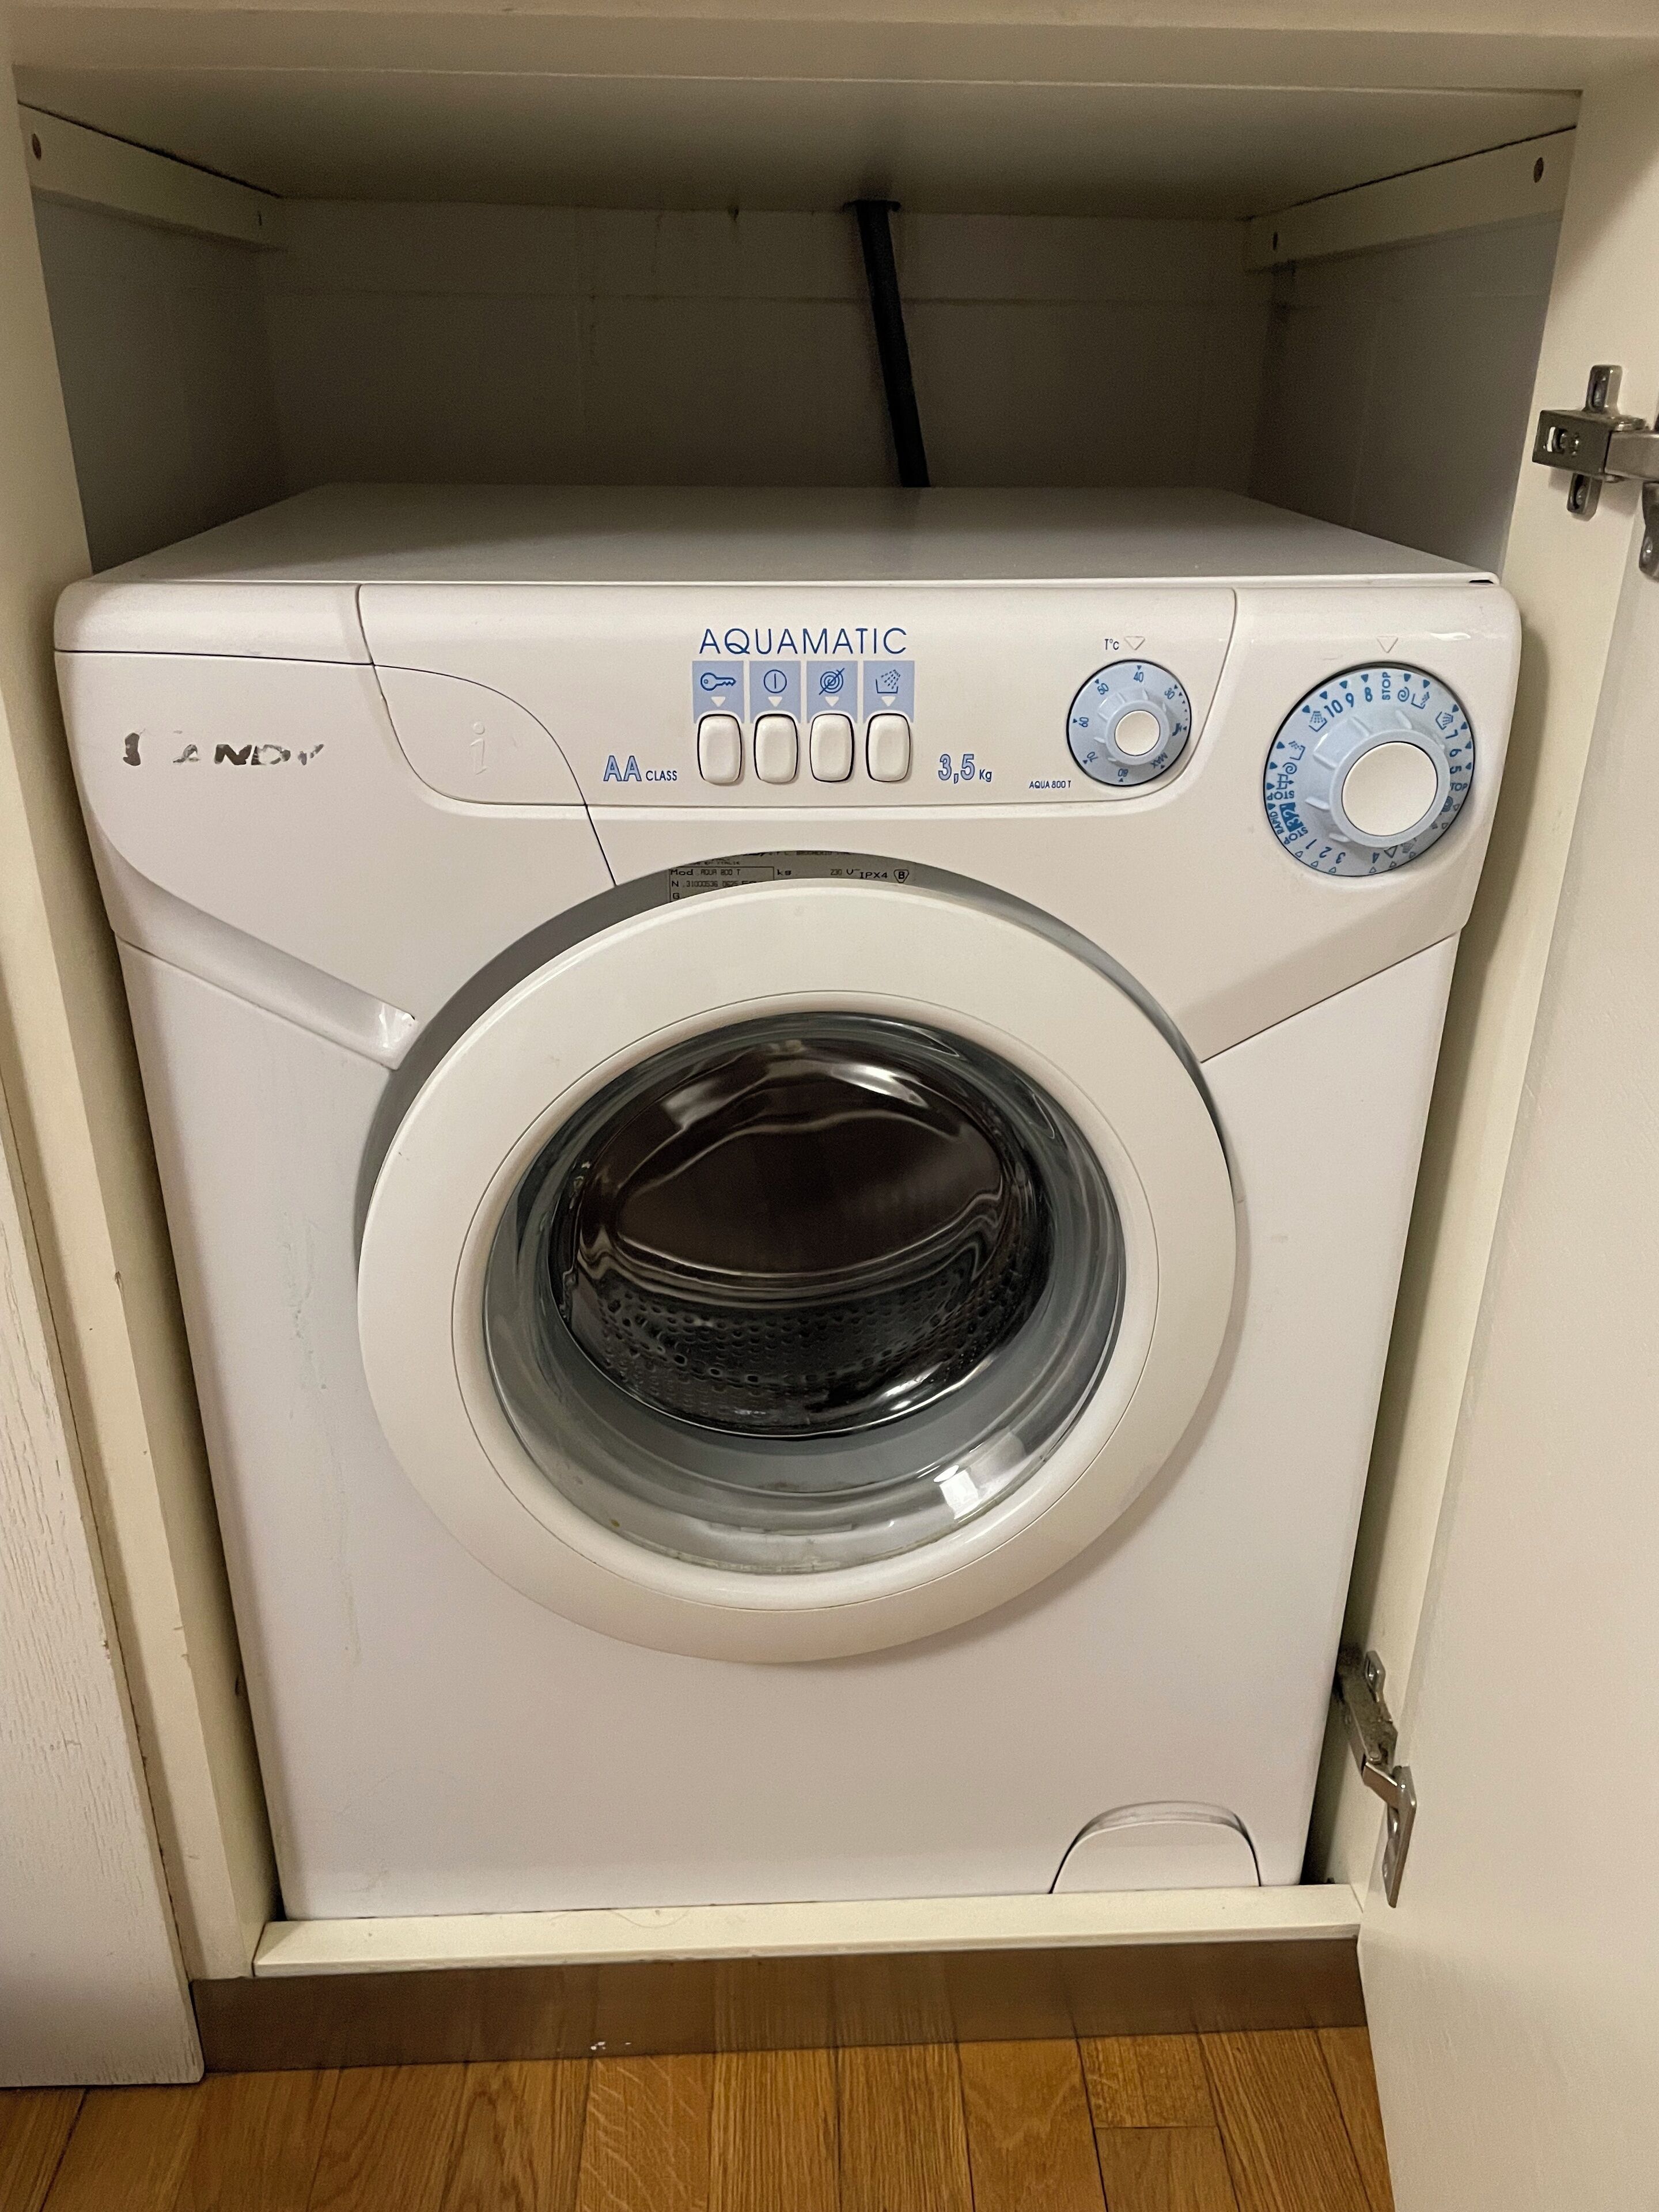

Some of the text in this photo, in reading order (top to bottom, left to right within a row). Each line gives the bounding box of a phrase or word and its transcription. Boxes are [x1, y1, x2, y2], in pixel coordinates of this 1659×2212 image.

[699, 627, 907, 655] AQUAMATIC
[1133, 671, 1144, 683] 40
[1097, 683, 1109, 695] 50
[1382, 672, 1391, 700] STOP
[1164, 687, 1175, 700] 30
[1364, 687, 1373, 703] 8
[1345, 692, 1354, 708] 9
[1323, 699, 1344, 718] 10
[1078, 717, 1089, 728] 60
[1445, 729, 1459, 739] 7
[1086, 751, 1099, 763] 70
[1449, 748, 1462, 757] 6
[1150, 752, 1168, 769] MAX
[603, 755, 677, 782] AA CLASS
[938, 753, 993, 784] 3,5 Kg
[1118, 768, 1128, 778] 80
[1449, 765, 1462, 774] 5
[1029, 780, 1071, 789] AQUA 800 T
[1449, 782, 1468, 791] TOP
[1267, 790, 1295, 801] STOP
[1270, 811, 1285, 835] RAPID
[1283, 827, 1309, 845] STOP
[1305, 839, 1317, 850] 1
[1319, 846, 1332, 858] 2
[1335, 852, 1346, 863] 3
[1372, 852, 1380, 863] 4
